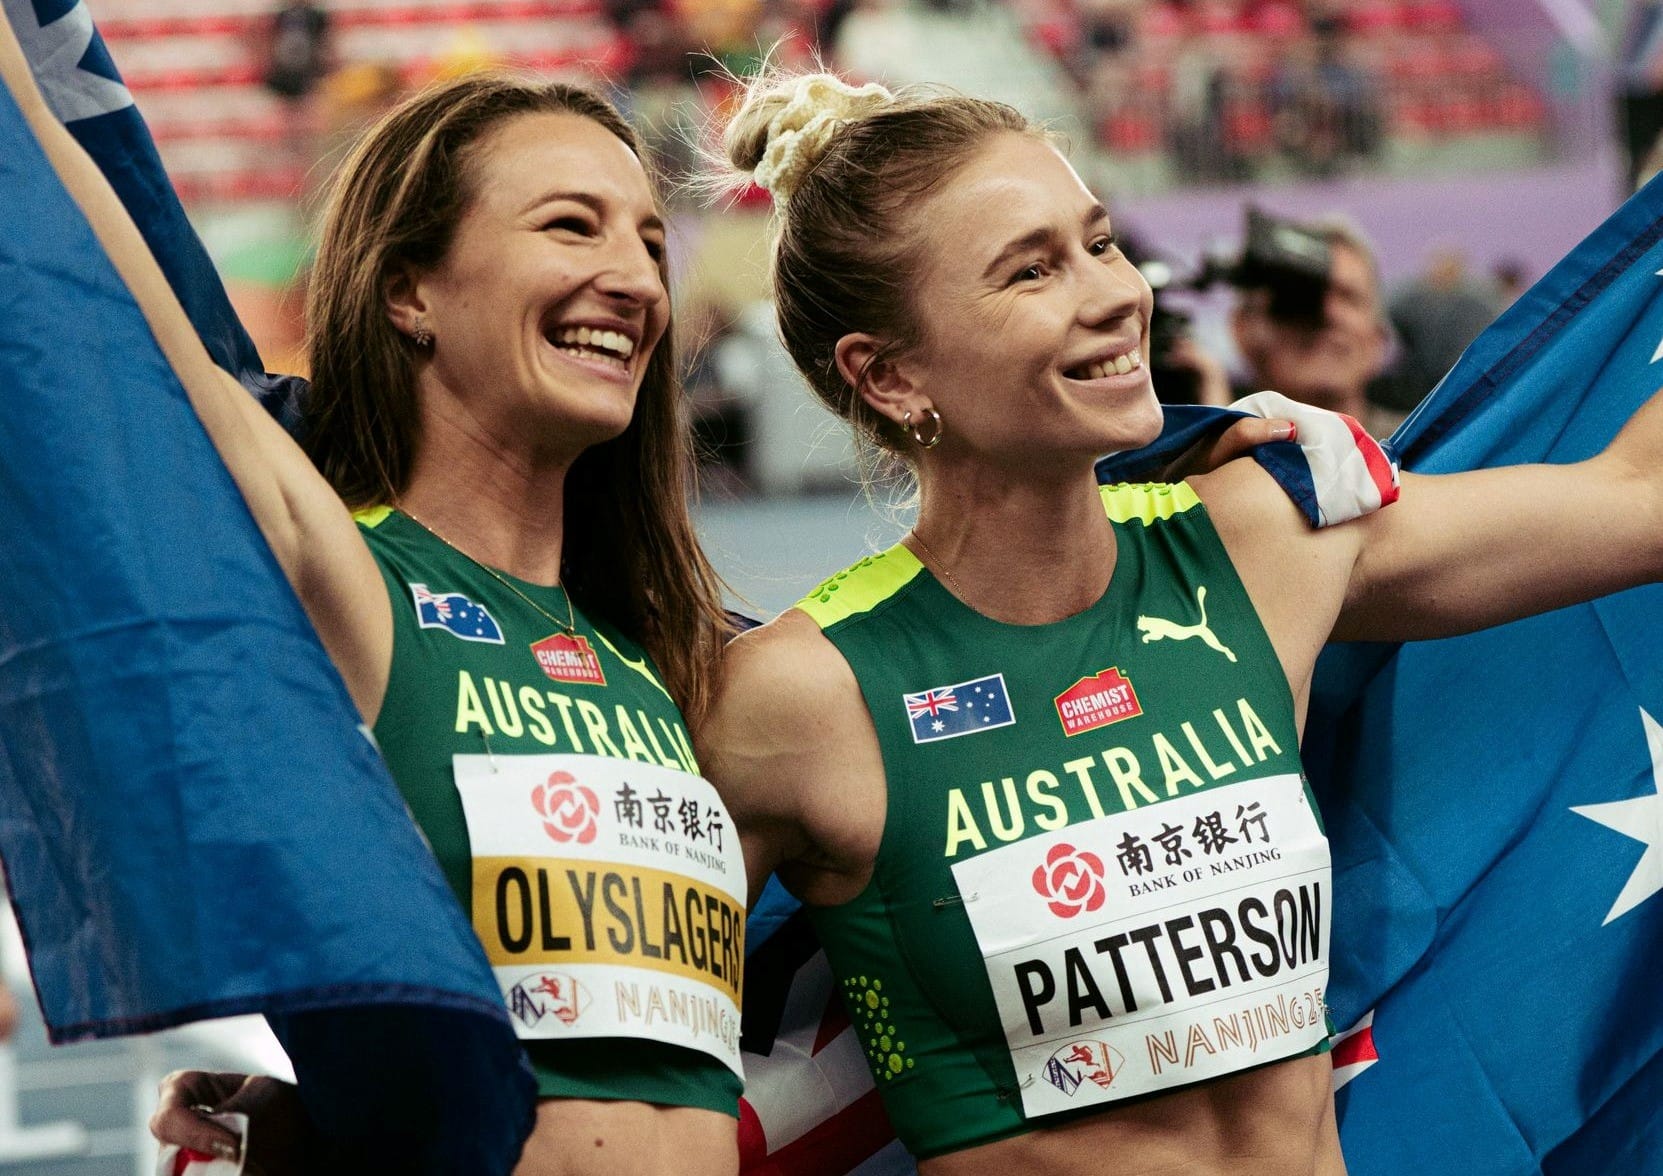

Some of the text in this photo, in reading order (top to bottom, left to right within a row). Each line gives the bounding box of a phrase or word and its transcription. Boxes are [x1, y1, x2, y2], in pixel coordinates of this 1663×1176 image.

[1061, 684, 1130, 719] CHEMIST
[1067, 702, 1134, 729] WAREHOUSE
[944, 698, 1283, 857] AUSTRALIA
[614, 781, 724, 852] 南京银行
[1116, 801, 1271, 876] 南京银行
[619, 833, 726, 875] BANK OF NANJING
[1129, 847, 1282, 897] BANK OF NANJING
[496, 866, 741, 994] OLYSLAGERS
[1013, 882, 1320, 1036] PATTERSON
